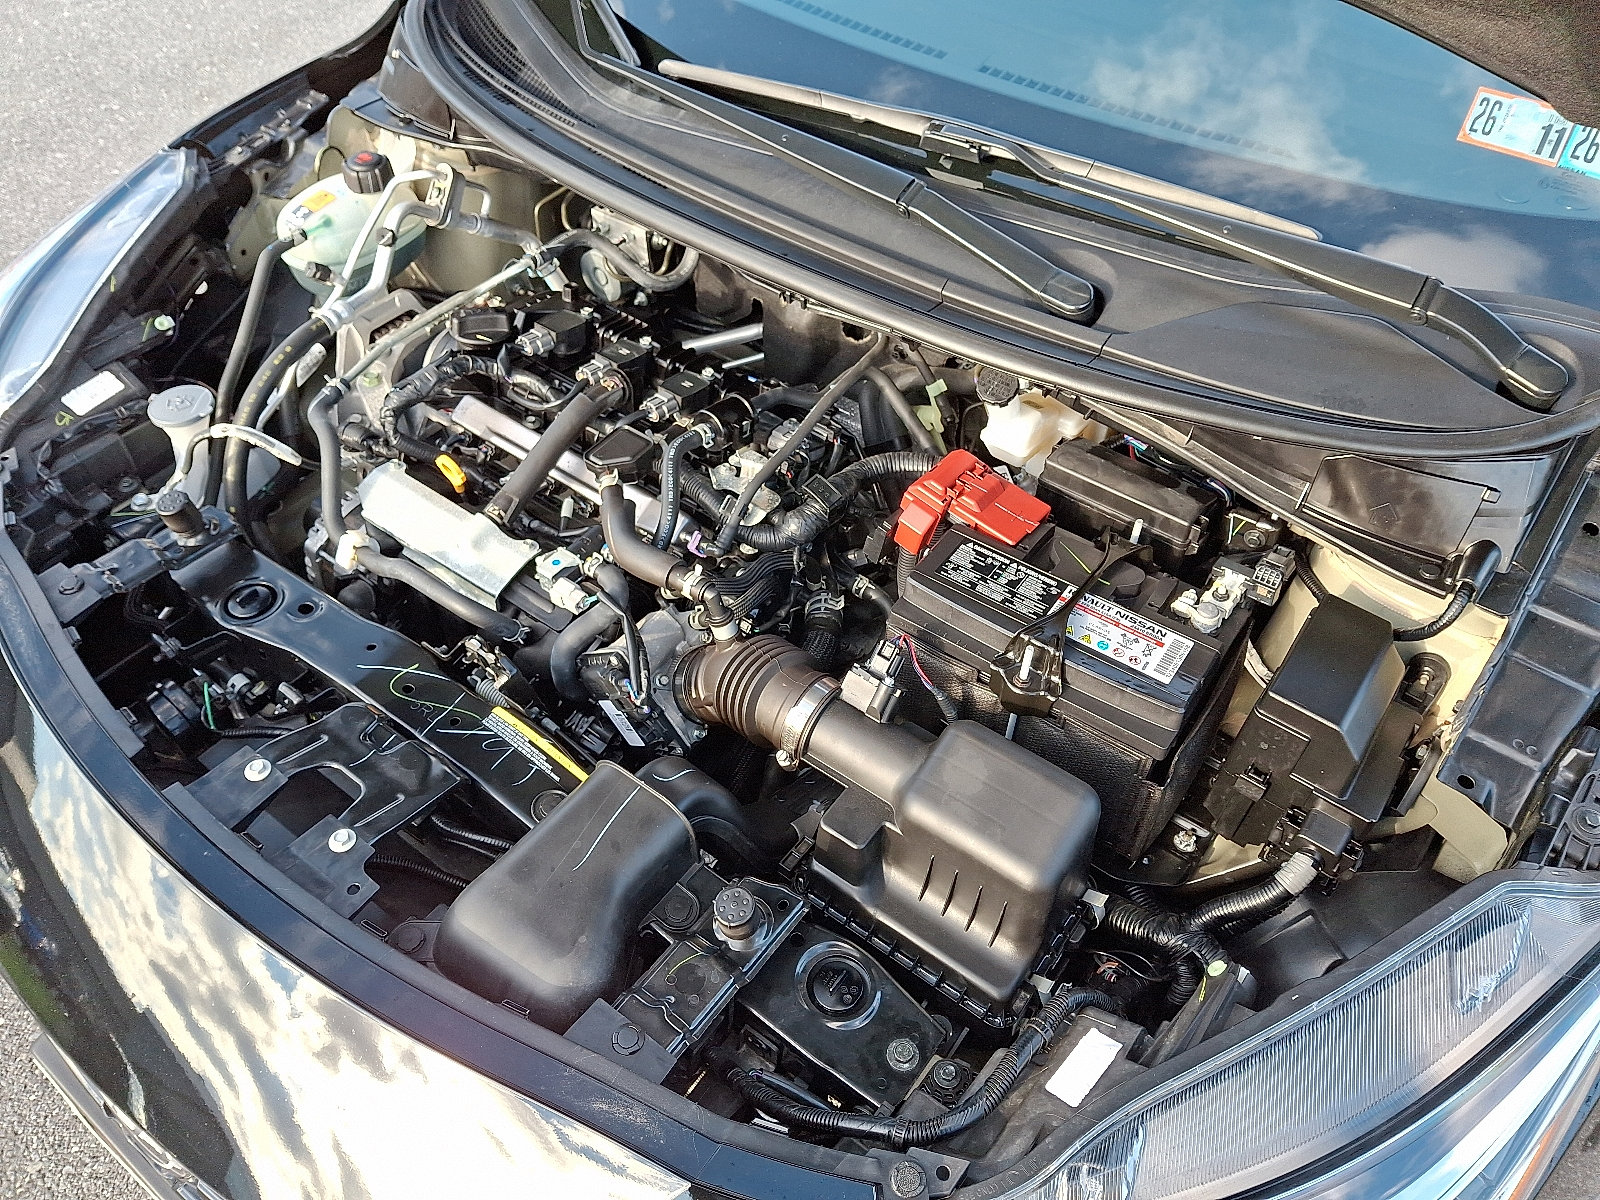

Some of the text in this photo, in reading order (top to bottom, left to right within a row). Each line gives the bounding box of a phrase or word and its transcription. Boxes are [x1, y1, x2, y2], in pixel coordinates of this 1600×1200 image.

[1468, 96, 1503, 136] 26
[1535, 123, 1568, 159] 11
[1570, 126, 1600, 164] 26
[1115, 608, 1168, 638] NISSAN
